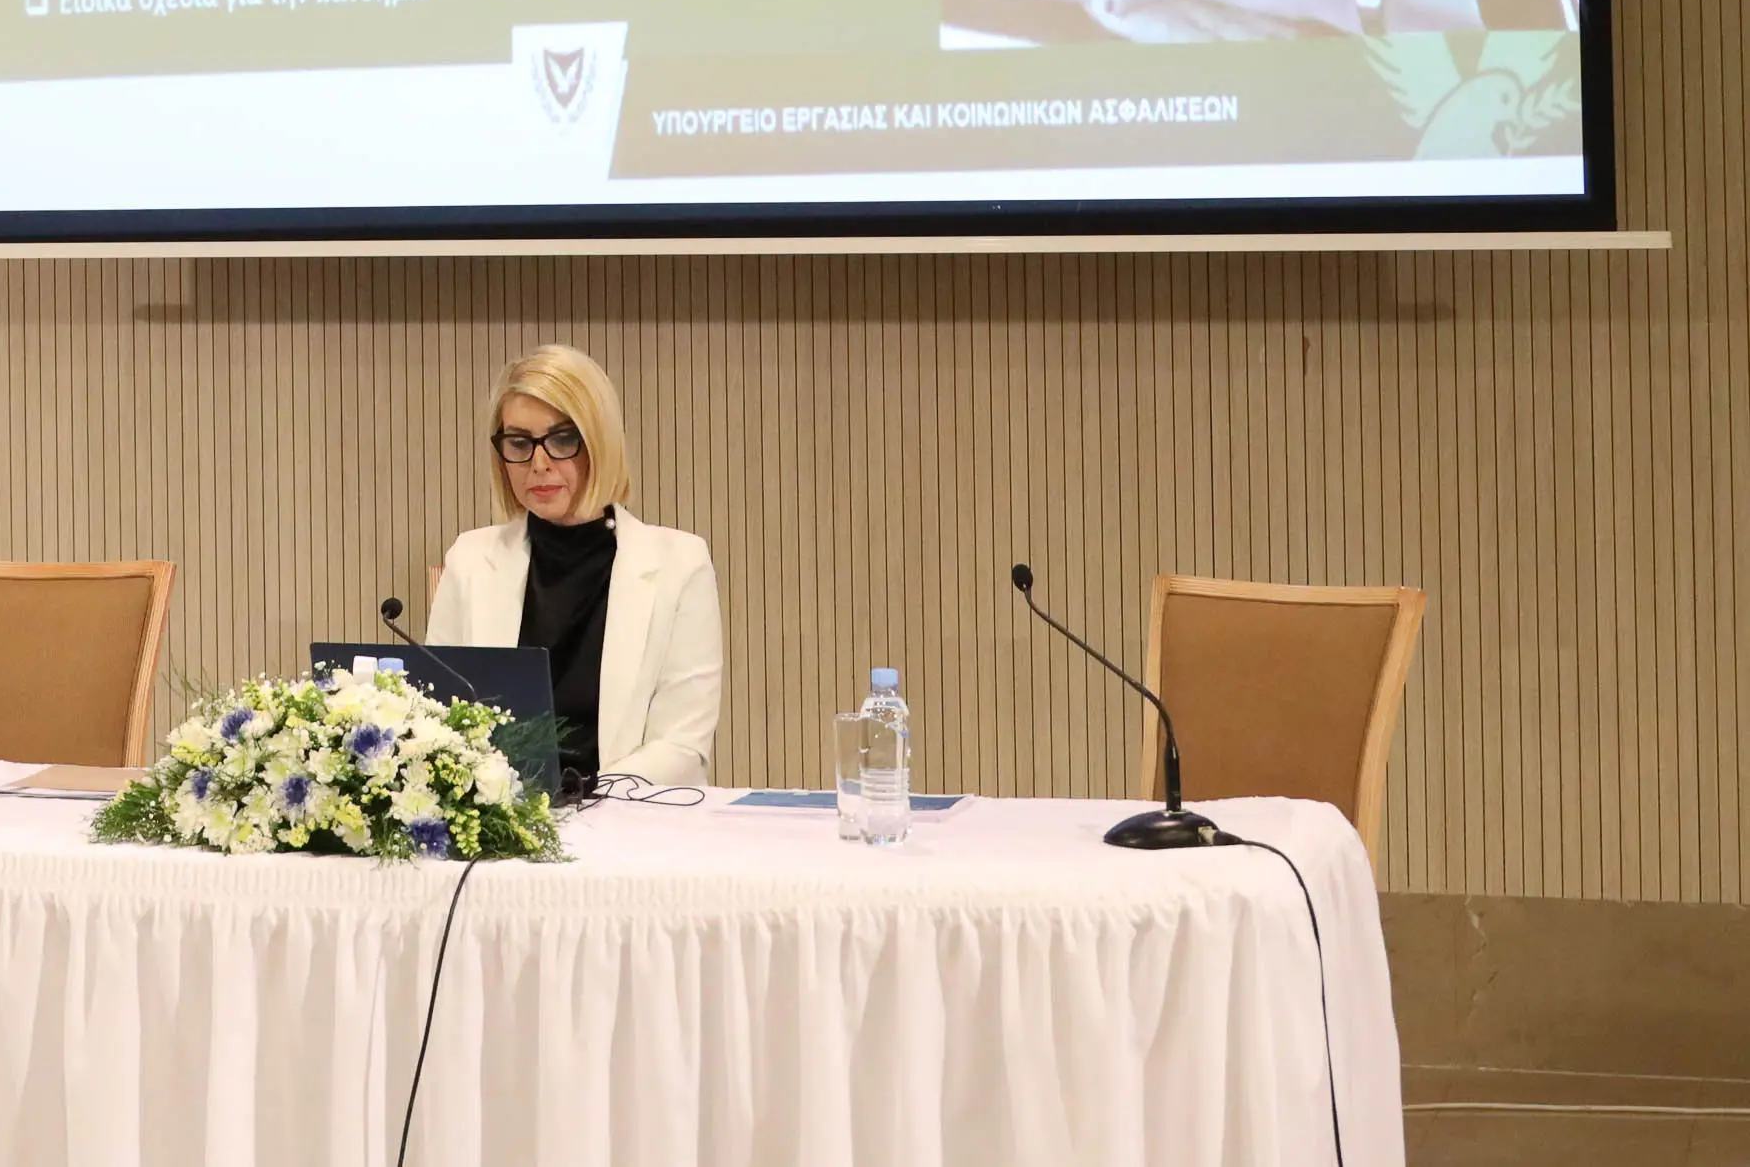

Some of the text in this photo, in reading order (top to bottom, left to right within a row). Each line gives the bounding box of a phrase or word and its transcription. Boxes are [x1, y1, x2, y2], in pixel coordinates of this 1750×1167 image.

[652, 96, 1238, 135] ΥΠΟΥΡΓΕΙΟ ΕΡΓΑΣΙΑΣ ΚΑΙ ΚΟΙΝΩΝΙΚΩΝ ΑΣΦΑΛΙΣΕΩΝ
